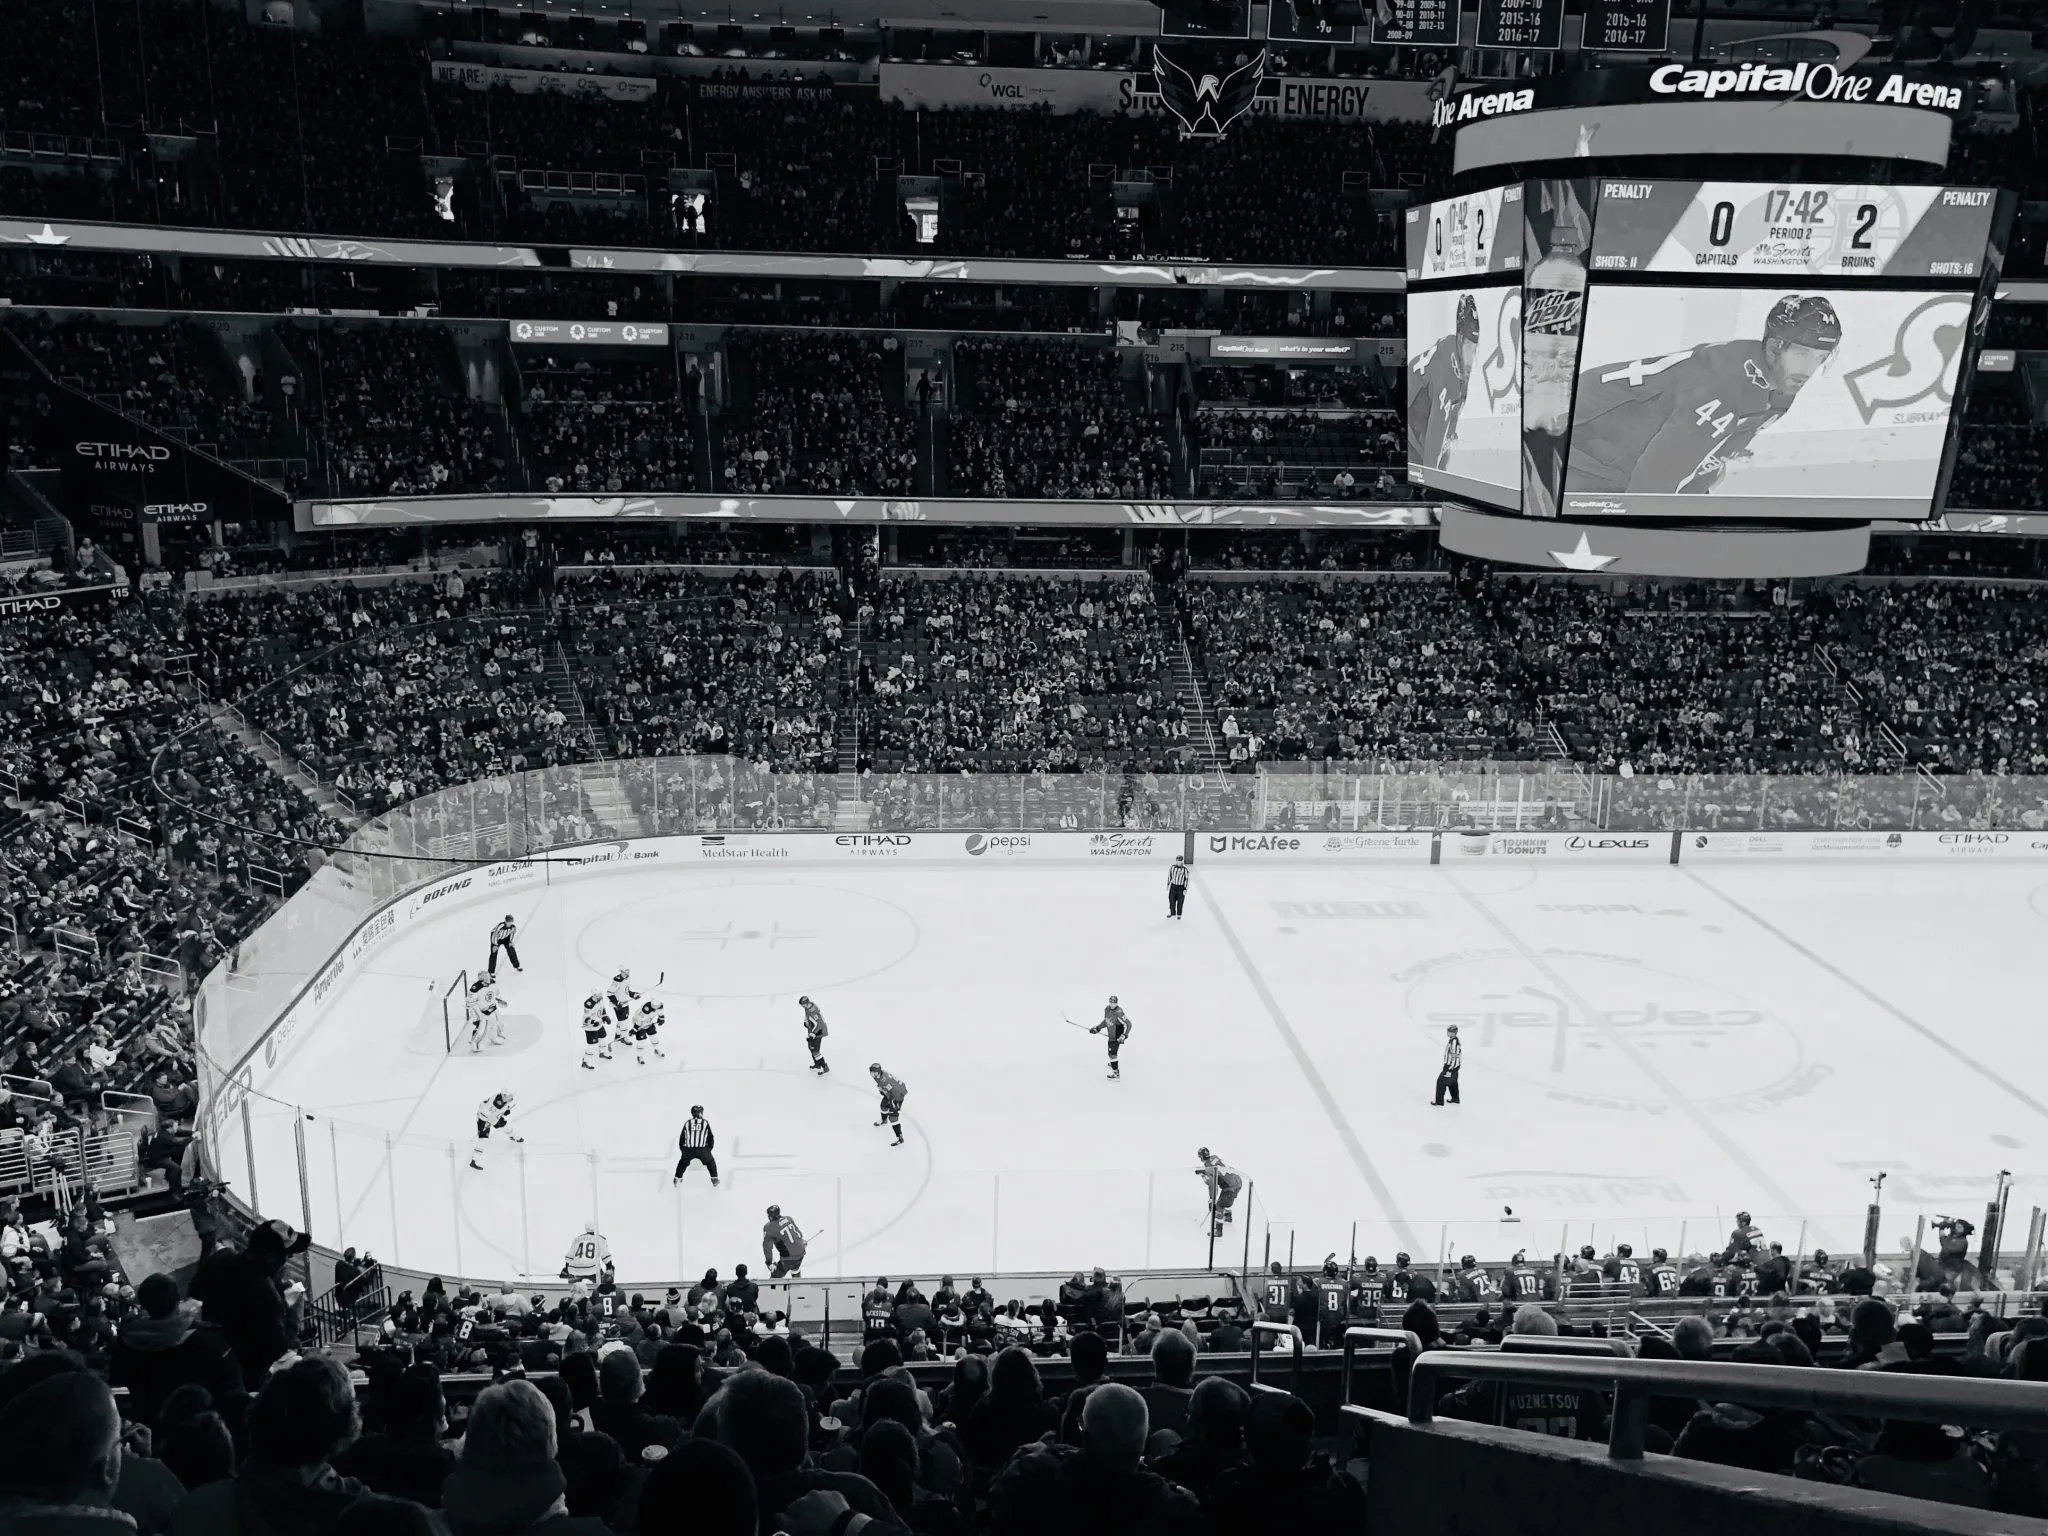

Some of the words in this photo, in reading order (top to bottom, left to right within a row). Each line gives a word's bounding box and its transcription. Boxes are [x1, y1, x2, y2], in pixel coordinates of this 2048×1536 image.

[1500, 12, 1541, 26] 2015-16
[1606, 13, 1647, 27] 2015-16
[1498, 28, 1540, 42] 2016-17
[1604, 29, 1646, 43] 2016-17
[439, 67, 455, 82] WE
[700, 84, 740, 99] ENERGY
[797, 87, 816, 101] ASK
[819, 88, 833, 101] US
[991, 85, 1025, 98] WGL
[1876, 75, 1962, 110] Arena
[1285, 84, 1370, 116] ENERGY
[1456, 89, 1535, 121] Arena
[1604, 184, 1653, 199] PENALTY
[1943, 191, 1990, 207] PENALTY
[1764, 190, 1828, 224] 17:42
[1477, 209, 1484, 250] 2
[1710, 201, 1735, 247] 0
[1851, 204, 1878, 250] 2
[1436, 217, 1442, 256] 0
[1770, 228, 1804, 239] PERIOD
[1805, 228, 1813, 240] 2
[1772, 243, 1816, 258] Sports
[1595, 256, 1628, 268] SHOTS:
[1695, 253, 1738, 266] CAPITALS
[1753, 257, 1809, 265] WASHINGTON
[1841, 256, 1876, 268] BRUINS
[1930, 262, 1963, 274] SHOTS:
[1170, 343, 1185, 352] 215
[1145, 353, 1160, 362] 216
[1695, 399, 1735, 439] 44
[76, 441, 171, 460] ETIHAD
[94, 461, 155, 473] AIRWAYS
[91, 504, 134, 520] ETIHAD
[144, 502, 207, 515] ETIHAD
[110, 588, 129, 599] 115
[0, 596, 61, 616] TIHAD
[835, 835, 912, 846] ETIHAD
[990, 834, 1031, 849] pepsi
[1109, 833, 1156, 848] Sports
[1231, 836, 1301, 850] McAfee
[1355, 836, 1391, 847] Greene
[1391, 836, 1419, 846] Turtle
[1588, 839, 1649, 848] LEXUS
[1938, 833, 2009, 844] ETIHAD
[633, 851, 659, 860] Bank
[702, 848, 749, 858] MedStar
[751, 848, 788, 858] Health
[1090, 848, 1152, 856] WASHINGTON
[1507, 846, 1547, 855] DONUTS
[423, 877, 472, 905] BOEING
[1425, 986, 1764, 1073] captals
[575, 1241, 596, 1260] 48
[1619, 1266, 1640, 1284] 43
[1518, 1276, 1537, 1296] 10
[1269, 1286, 1286, 1305] 31
[1328, 1291, 1338, 1311] 8
[1361, 1290, 1382, 1308] 39
[602, 1297, 613, 1316] 8
[459, 1320, 473, 1340] 8
[1509, 1393, 1579, 1411] KUZNETSOV
